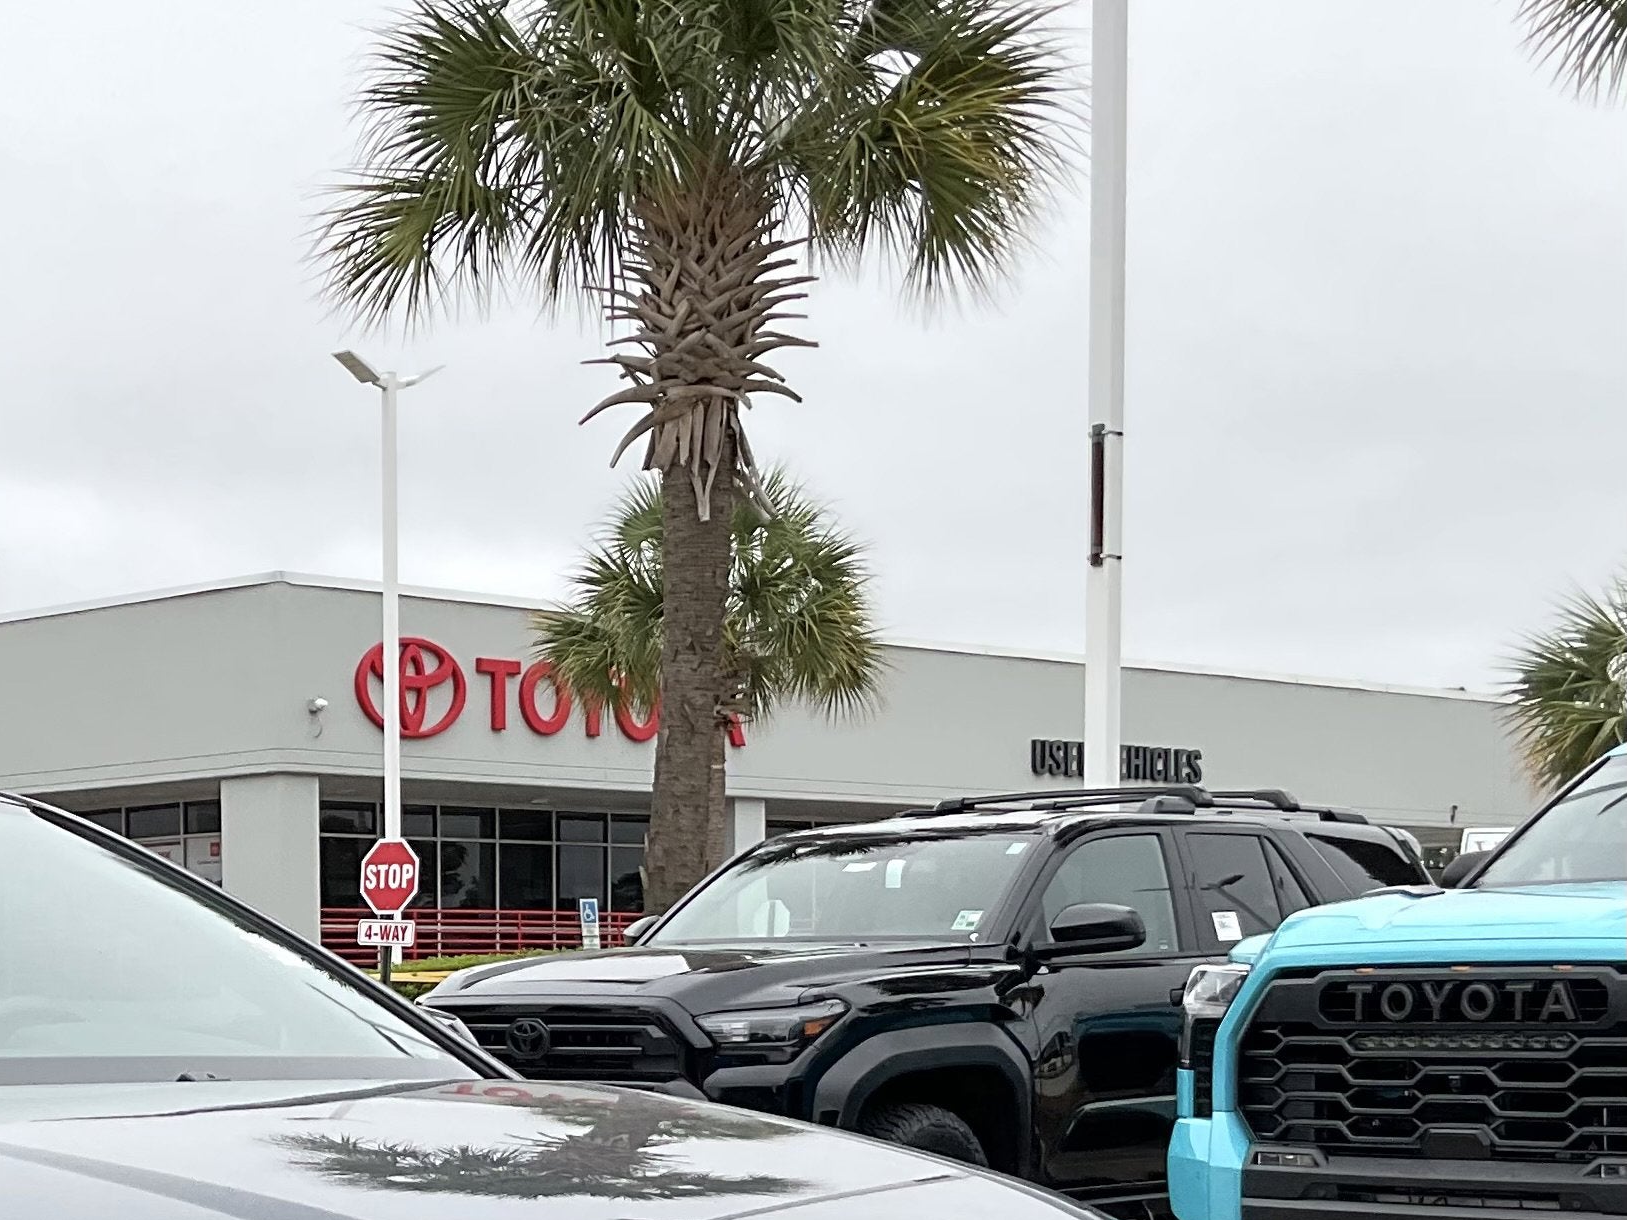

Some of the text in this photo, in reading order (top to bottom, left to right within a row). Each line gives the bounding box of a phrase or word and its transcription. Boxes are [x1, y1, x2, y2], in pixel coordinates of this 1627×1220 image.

[475, 657, 747, 748] TOO
[1031, 739, 1203, 784] USE EHICLES
[365, 863, 414, 890] STOP
[364, 924, 408, 942] 4-WAY
[1347, 980, 1579, 1022] TOYOTA
